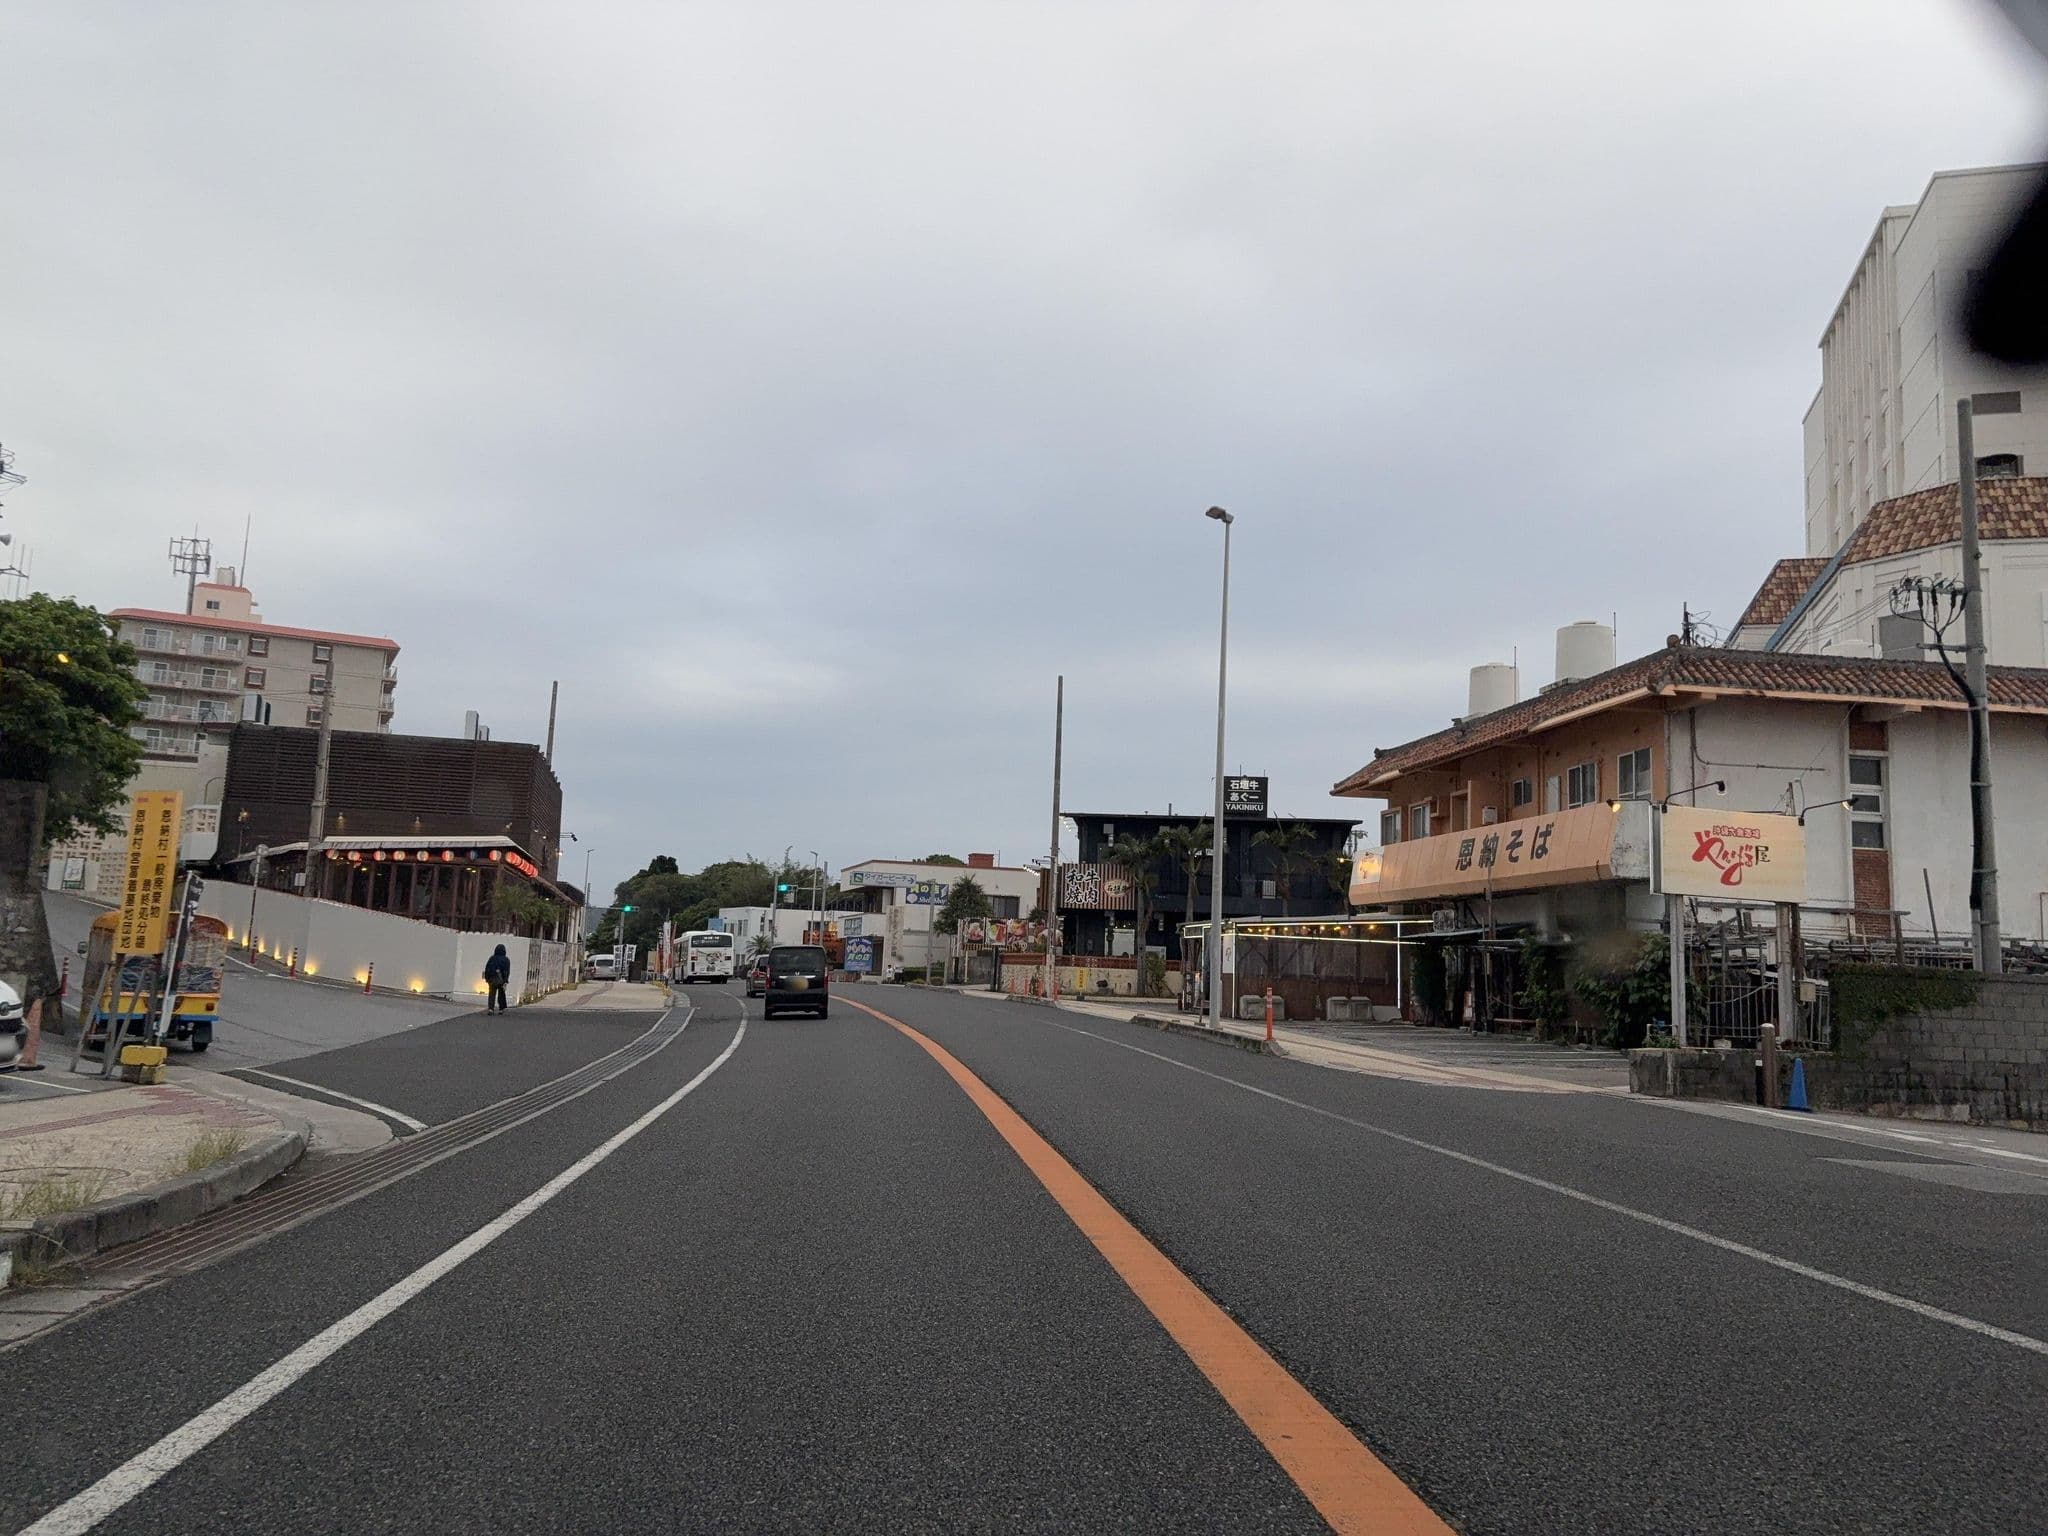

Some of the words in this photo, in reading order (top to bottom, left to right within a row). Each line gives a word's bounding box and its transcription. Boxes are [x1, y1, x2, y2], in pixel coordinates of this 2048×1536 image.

[1230, 780, 1259, 790] 石垣牛
[1230, 792, 1259, 802] あぐー
[1225, 803, 1264, 811] YAKINIKU
[1455, 822, 1555, 871] 恩納そば
[864, 873, 908, 882] タイガービーチ
[1066, 868, 1101, 886] 和牛
[1064, 886, 1100, 905] 焼肉
